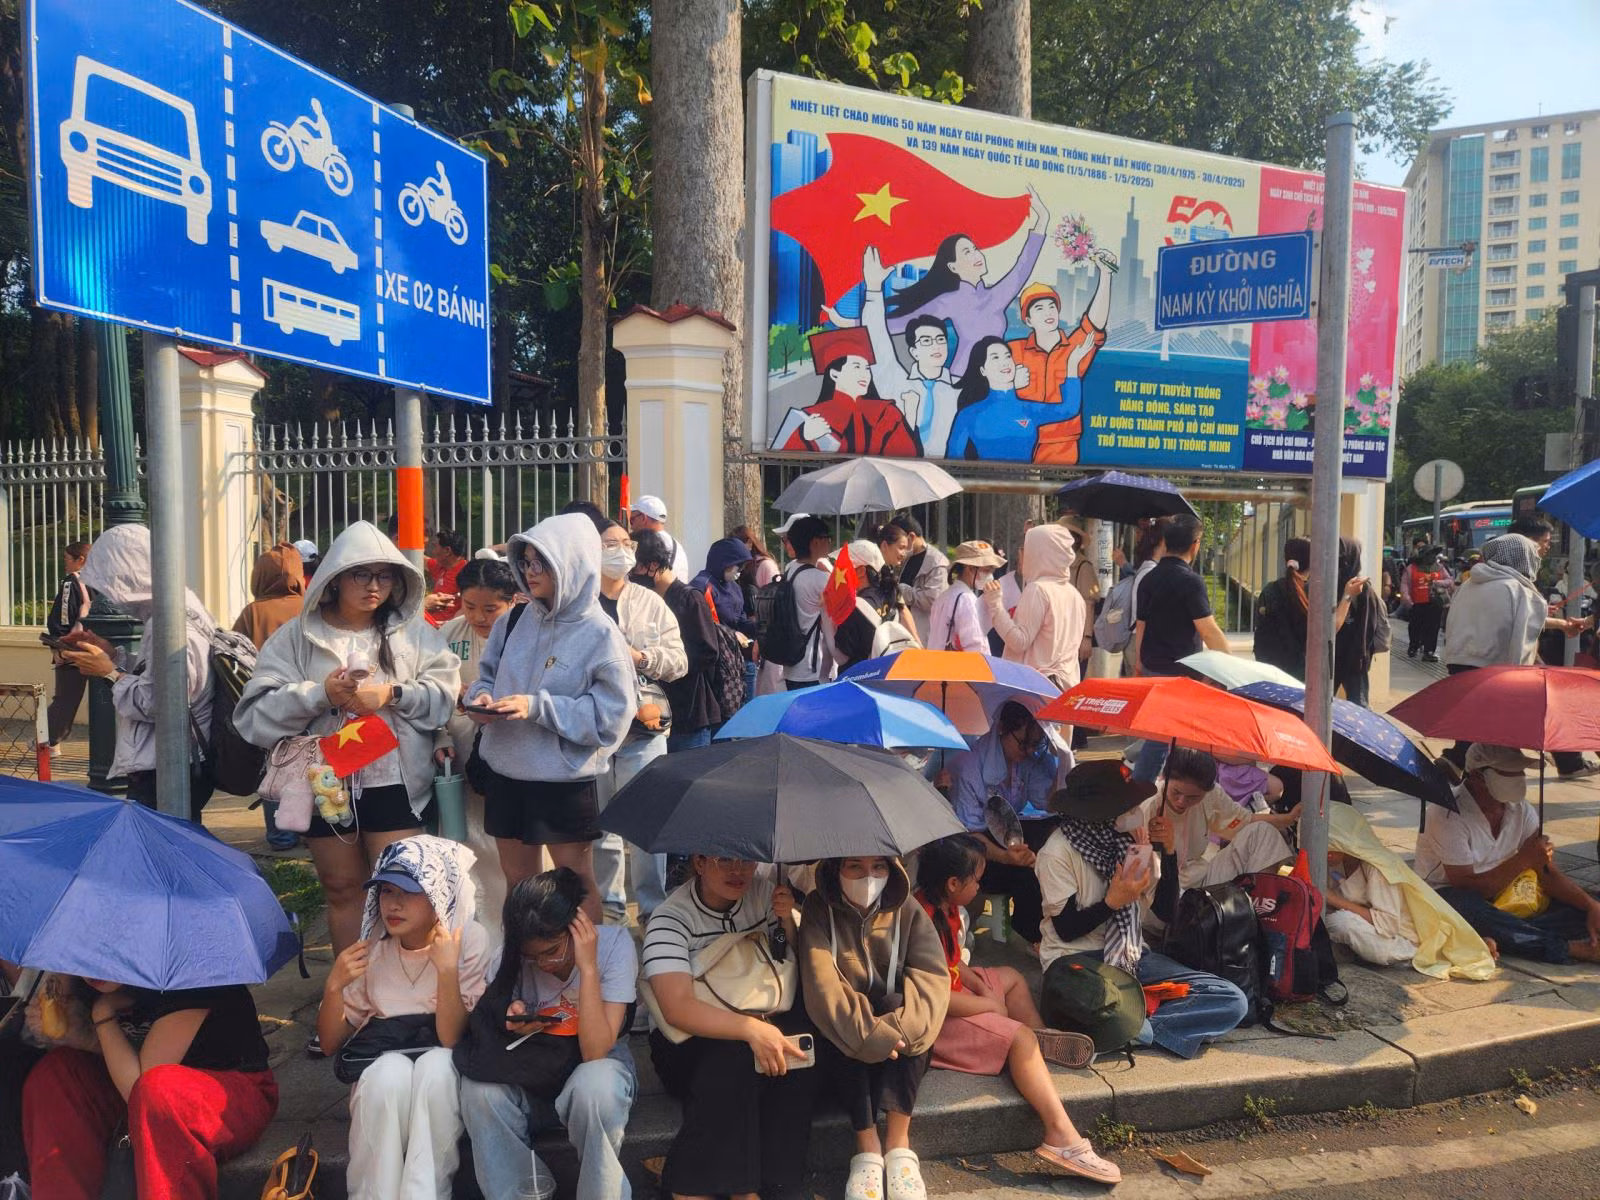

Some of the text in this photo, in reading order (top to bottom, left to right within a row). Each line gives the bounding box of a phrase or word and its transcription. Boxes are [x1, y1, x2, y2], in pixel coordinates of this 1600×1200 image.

[902, 119, 913, 130] 50
[917, 121, 936, 134] NĂM
[1039, 144, 1060, 157] NAM,
[1154, 163, 1196, 180] (30/4/1975
[1202, 172, 1245, 188] 30/4/2025)
[921, 139, 937, 151] 139
[940, 142, 960, 155] NĂM
[1025, 158, 1040, 169] LAO
[1115, 173, 1154, 188] 1/5/2025)
[1190, 249, 1277, 276] ĐƯỜNG
[384, 269, 485, 329] XE 02 BÁNH
[1162, 278, 1303, 318] NAM KỲ KHỞI NGHĨA
[1115, 380, 1221, 400] PHÁT HUY TRUYỀN THỐNG
[1120, 398, 1214, 418] NĂNG ĐỘNG, SÁNG TẠO
[1090, 414, 1239, 436] XÂY DỰNG THÀNH PHỐ HỒ CHÍ MINH
[1097, 432, 1231, 453] TRỞ THÀNH ĐÔ THỊ THÔNG MINH
